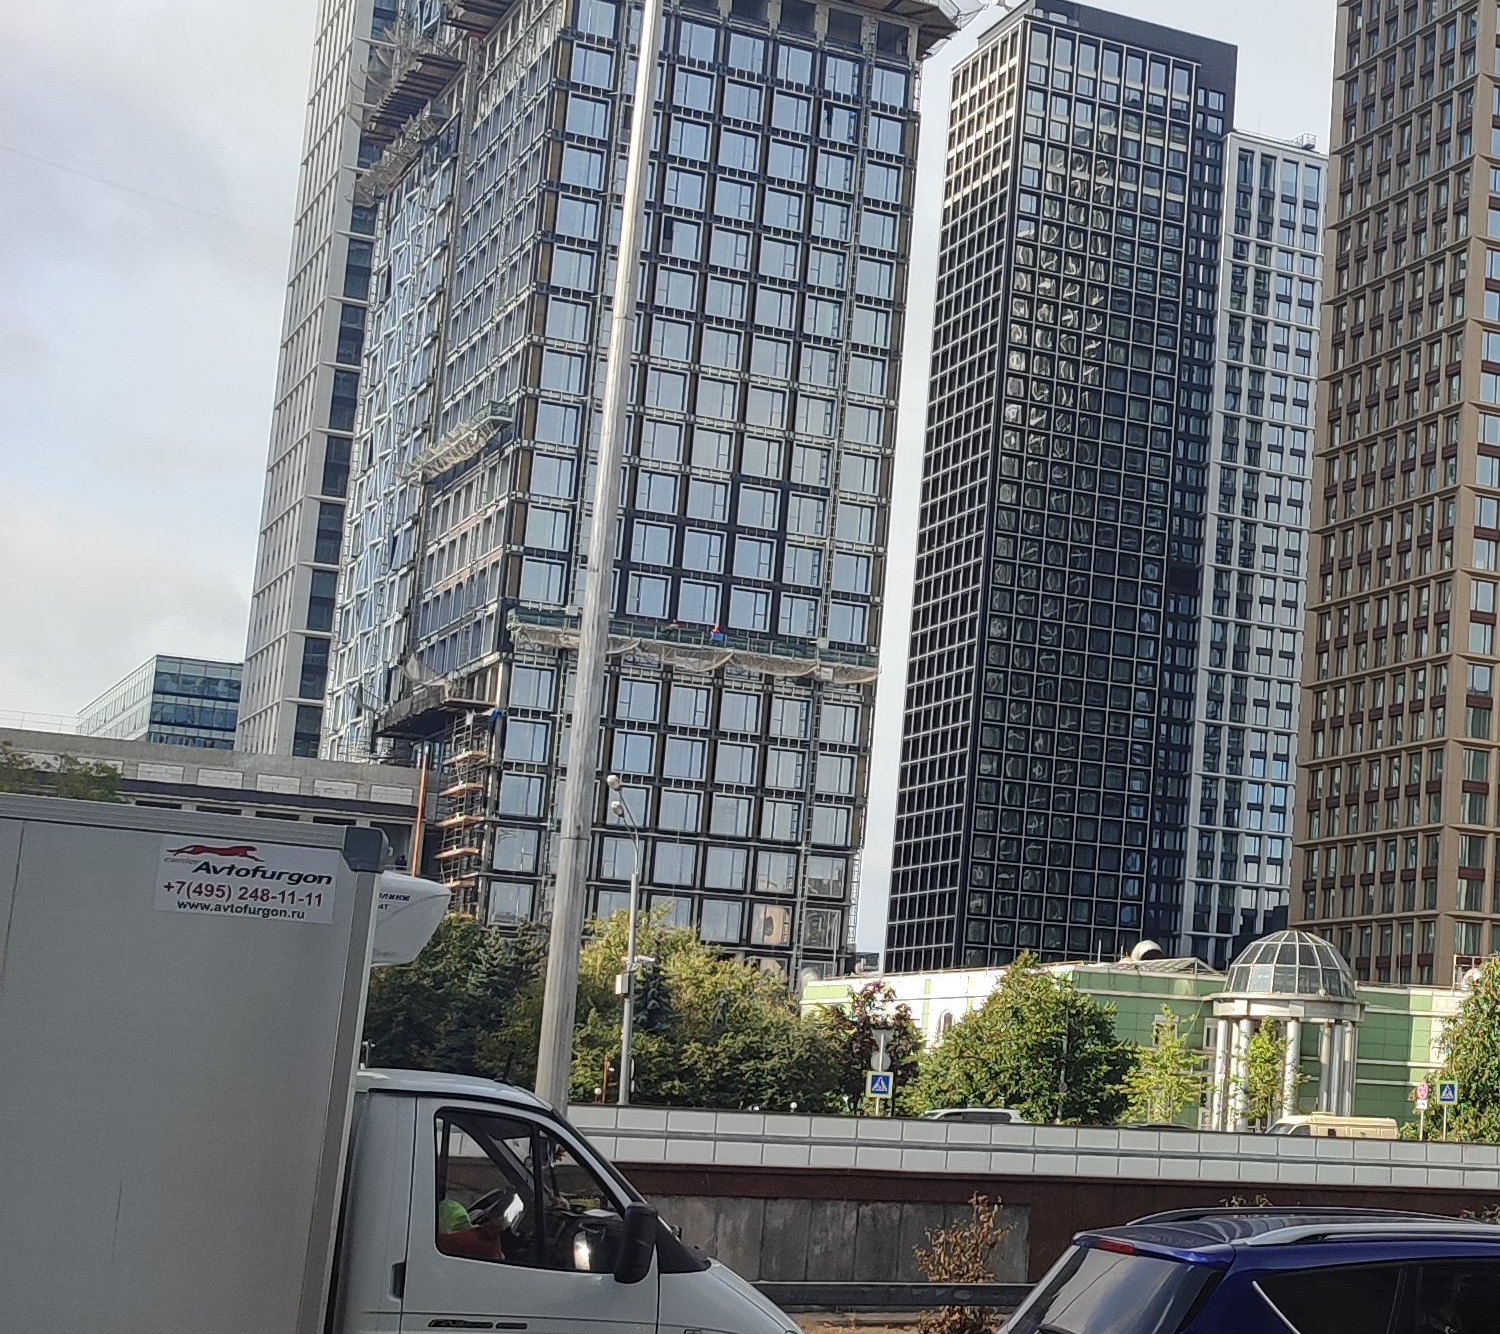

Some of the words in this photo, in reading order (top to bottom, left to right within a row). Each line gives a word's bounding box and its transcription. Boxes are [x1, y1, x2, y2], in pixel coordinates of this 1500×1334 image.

[192, 861, 333, 886] Avtofurgon
[163, 880, 232, 903] +7(495)
[237, 886, 323, 907] 248-11-11
[177, 900, 306, 919] www.avtofurgon.ru
